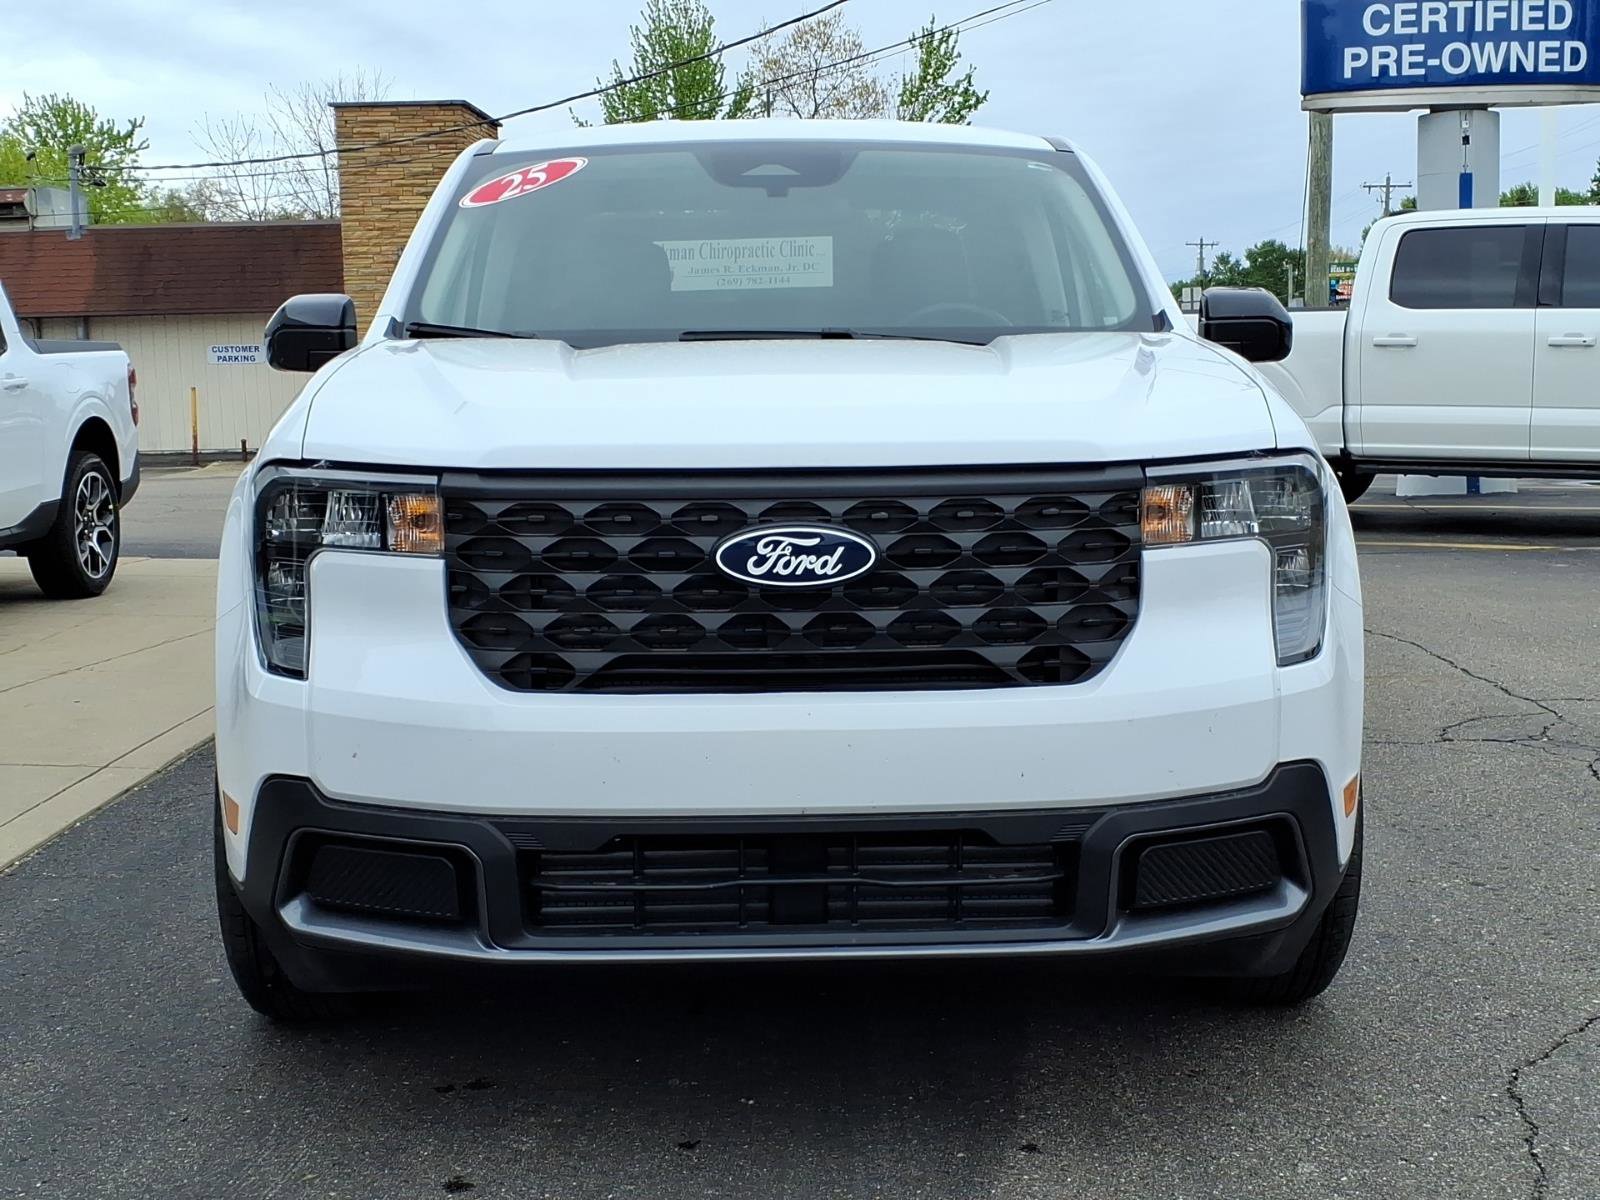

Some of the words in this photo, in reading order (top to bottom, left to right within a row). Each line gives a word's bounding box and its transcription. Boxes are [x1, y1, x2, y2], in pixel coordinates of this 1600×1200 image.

[1362, 0, 1573, 36] CERTIFIED
[1343, 41, 1588, 78] PRE-OWNED
[498, 162, 549, 200] 25
[665, 245, 695, 261] man
[699, 240, 776, 264] Chiropractic
[779, 239, 816, 258] Clinic
[688, 266, 721, 275] James
[716, 278, 743, 287] (269)
[211, 345, 260, 353] CUSTOMER
[217, 355, 256, 363] PARKING
[747, 536, 845, 575] Ford
